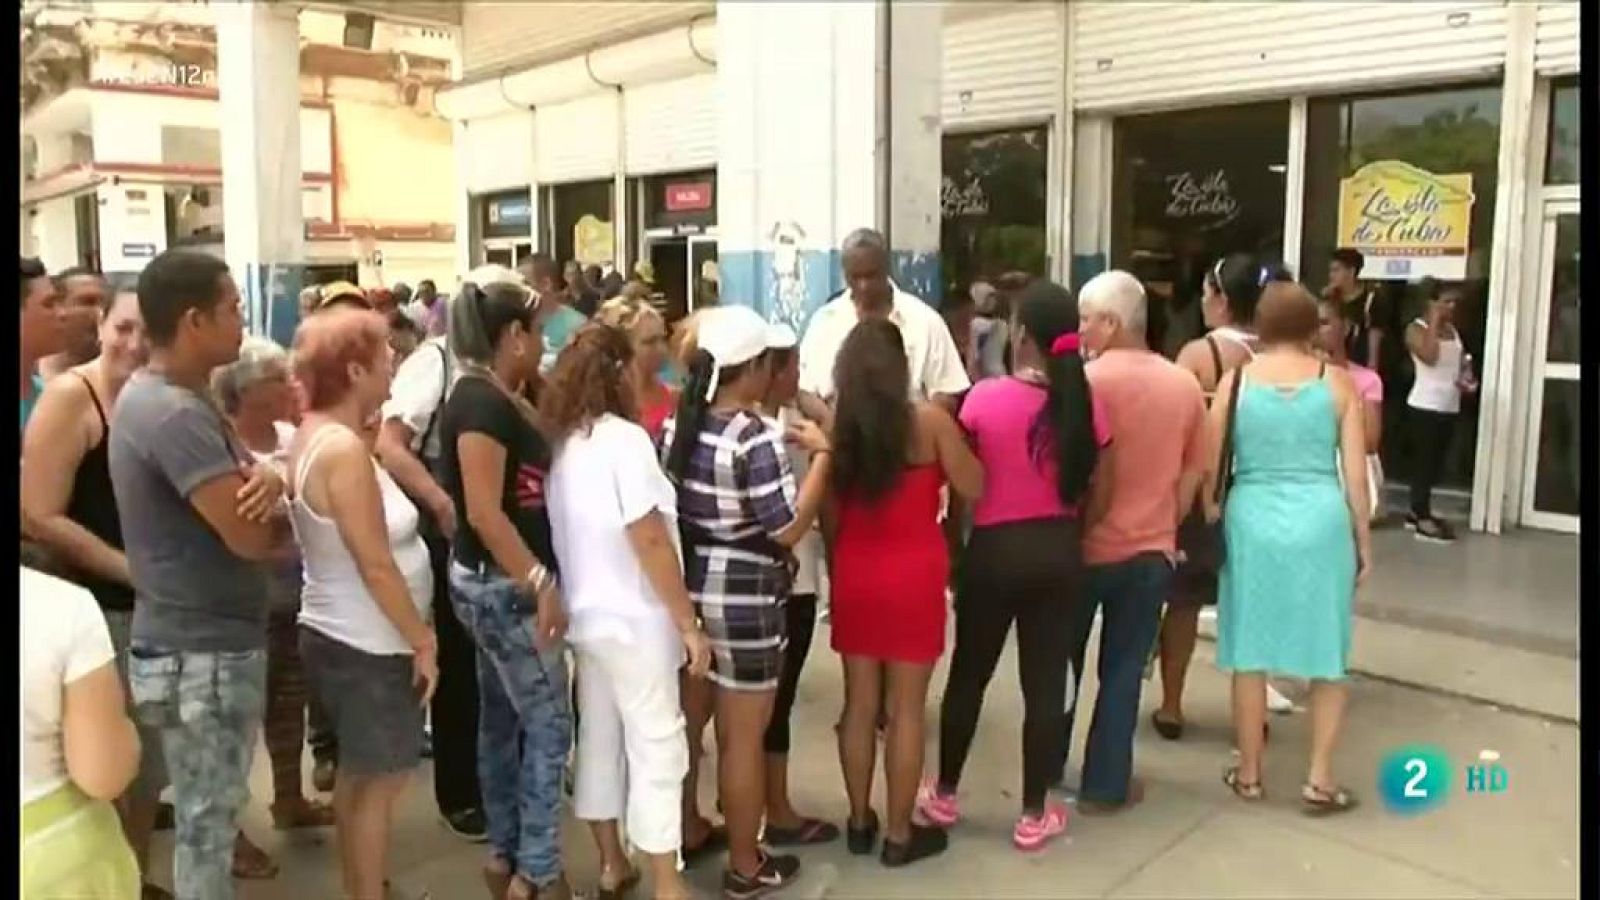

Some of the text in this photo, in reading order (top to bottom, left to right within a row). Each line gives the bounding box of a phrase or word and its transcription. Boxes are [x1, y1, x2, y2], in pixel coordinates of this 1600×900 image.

[1361, 184, 1440, 223] La isla
[1351, 215, 1453, 243] de Cuba
